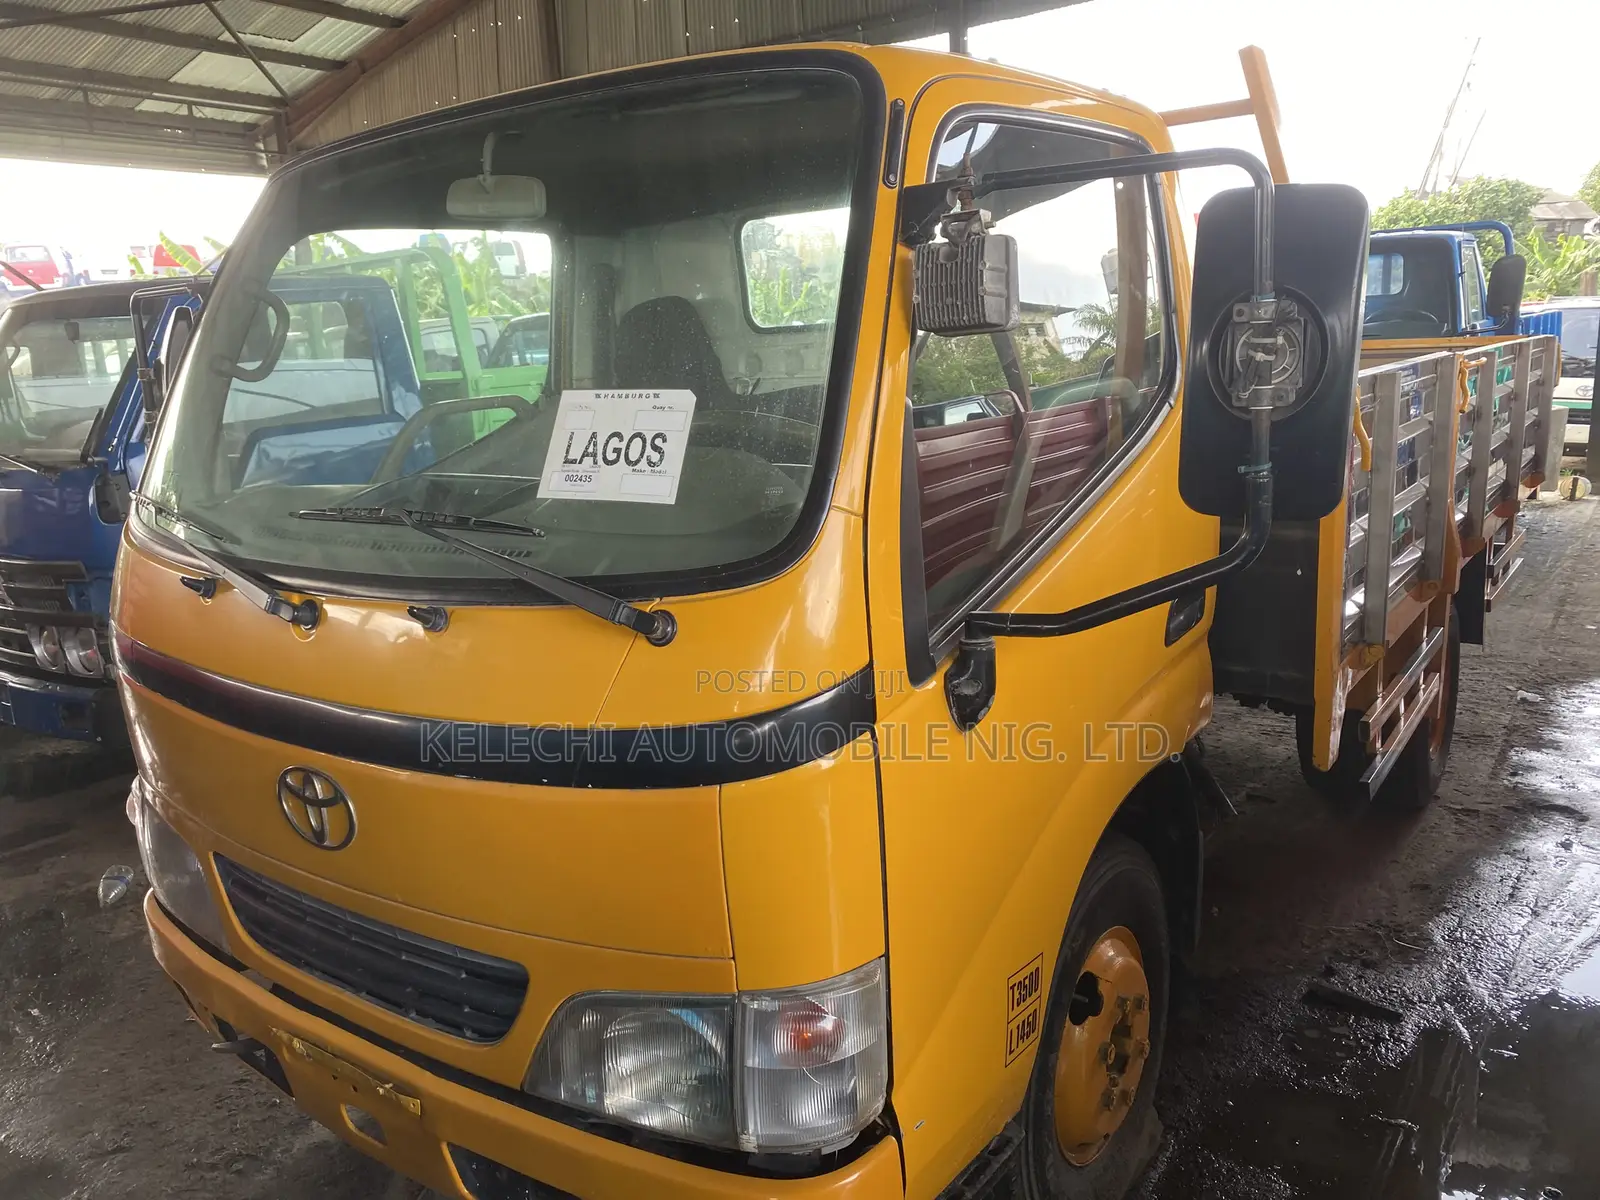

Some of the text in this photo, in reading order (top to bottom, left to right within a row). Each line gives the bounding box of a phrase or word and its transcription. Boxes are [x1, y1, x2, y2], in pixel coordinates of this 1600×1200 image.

[603, 392, 651, 400] HAMBURG
[563, 431, 668, 468] LAGOS
[564, 474, 593, 483] 002435
[1009, 966, 1040, 1012] T3500
[1008, 1008, 1038, 1056] L1450
